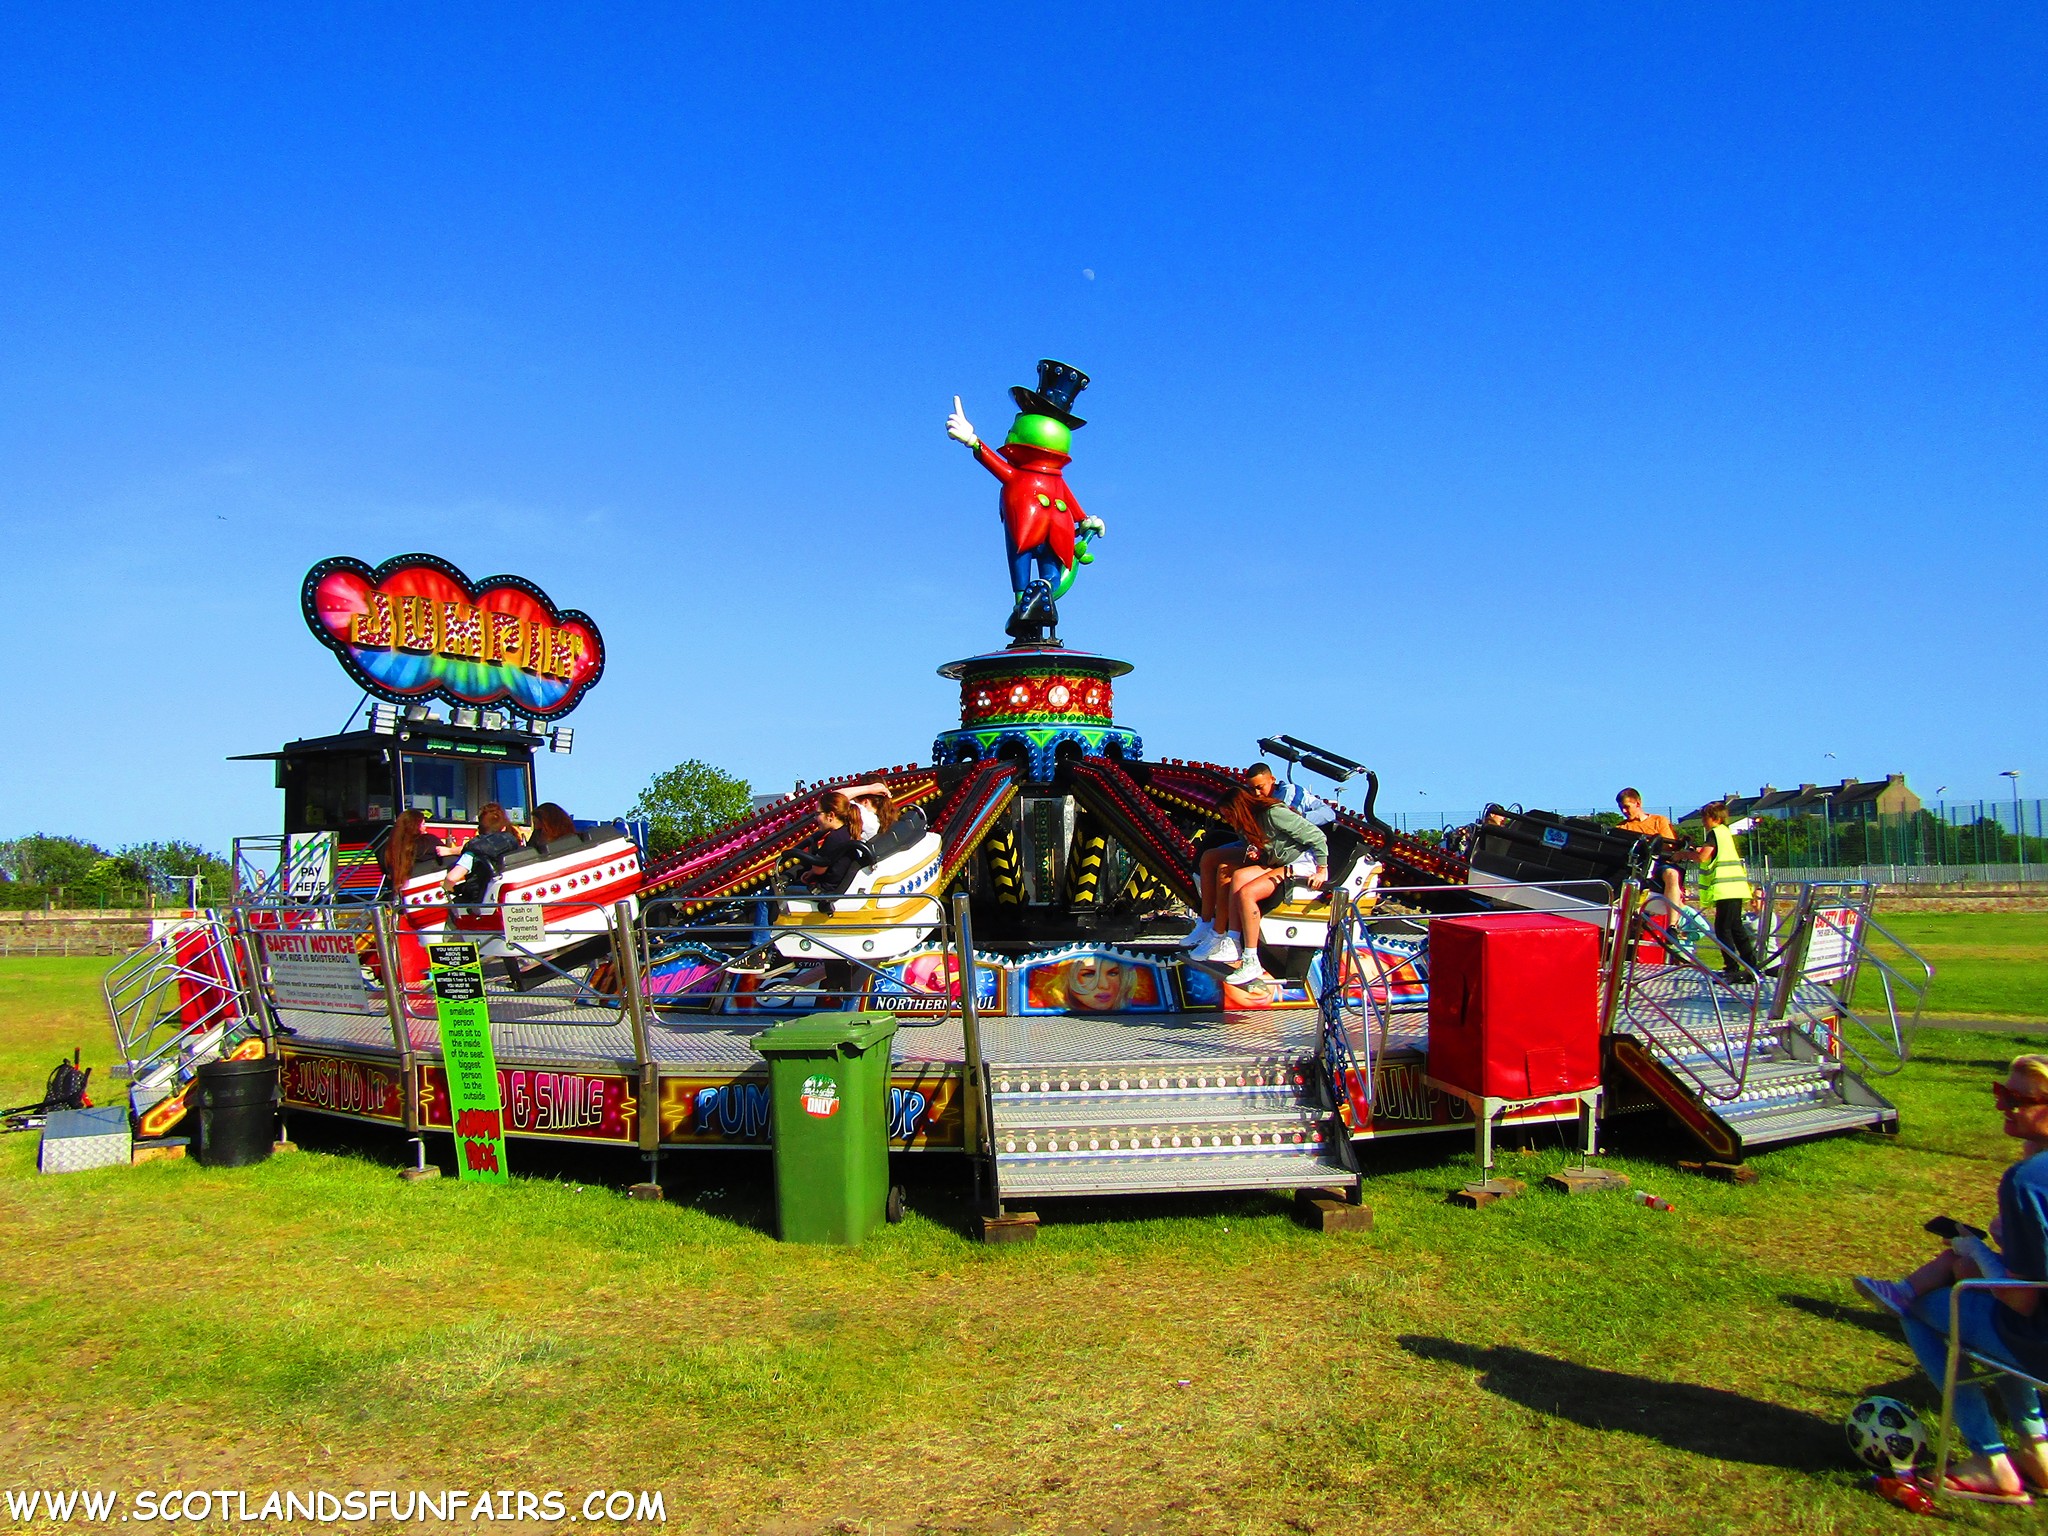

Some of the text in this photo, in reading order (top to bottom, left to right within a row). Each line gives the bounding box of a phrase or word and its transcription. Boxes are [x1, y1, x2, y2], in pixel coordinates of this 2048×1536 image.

[301, 867, 321, 877] PAY
[1355, 876, 1363, 886] 6
[296, 881, 326, 892] HERE
[266, 934, 356, 954] SAFETY NOTICE
[275, 953, 351, 964] THIS RIDE IS BOISTEROUS.
[956, 996, 995, 1010] SUL
[449, 1007, 475, 1015] smallest
[453, 1019, 475, 1027] person
[465, 1028, 473, 1036] sit
[452, 1039, 481, 1047] the inside
[451, 1049, 458, 1057] of
[458, 1049, 469, 1058] the
[459, 1060, 481, 1070] biggest
[461, 1071, 482, 1080] person
[297, 1059, 389, 1112] JUST DO IT
[464, 1081, 482, 1089] to the
[463, 1092, 486, 1100] outside
[511, 1071, 530, 1128] &
[534, 1072, 604, 1130] SMILE
[807, 1097, 833, 1115] ONLY
[698, 1083, 771, 1142] PUM
[464, 1139, 499, 1175] FROG
